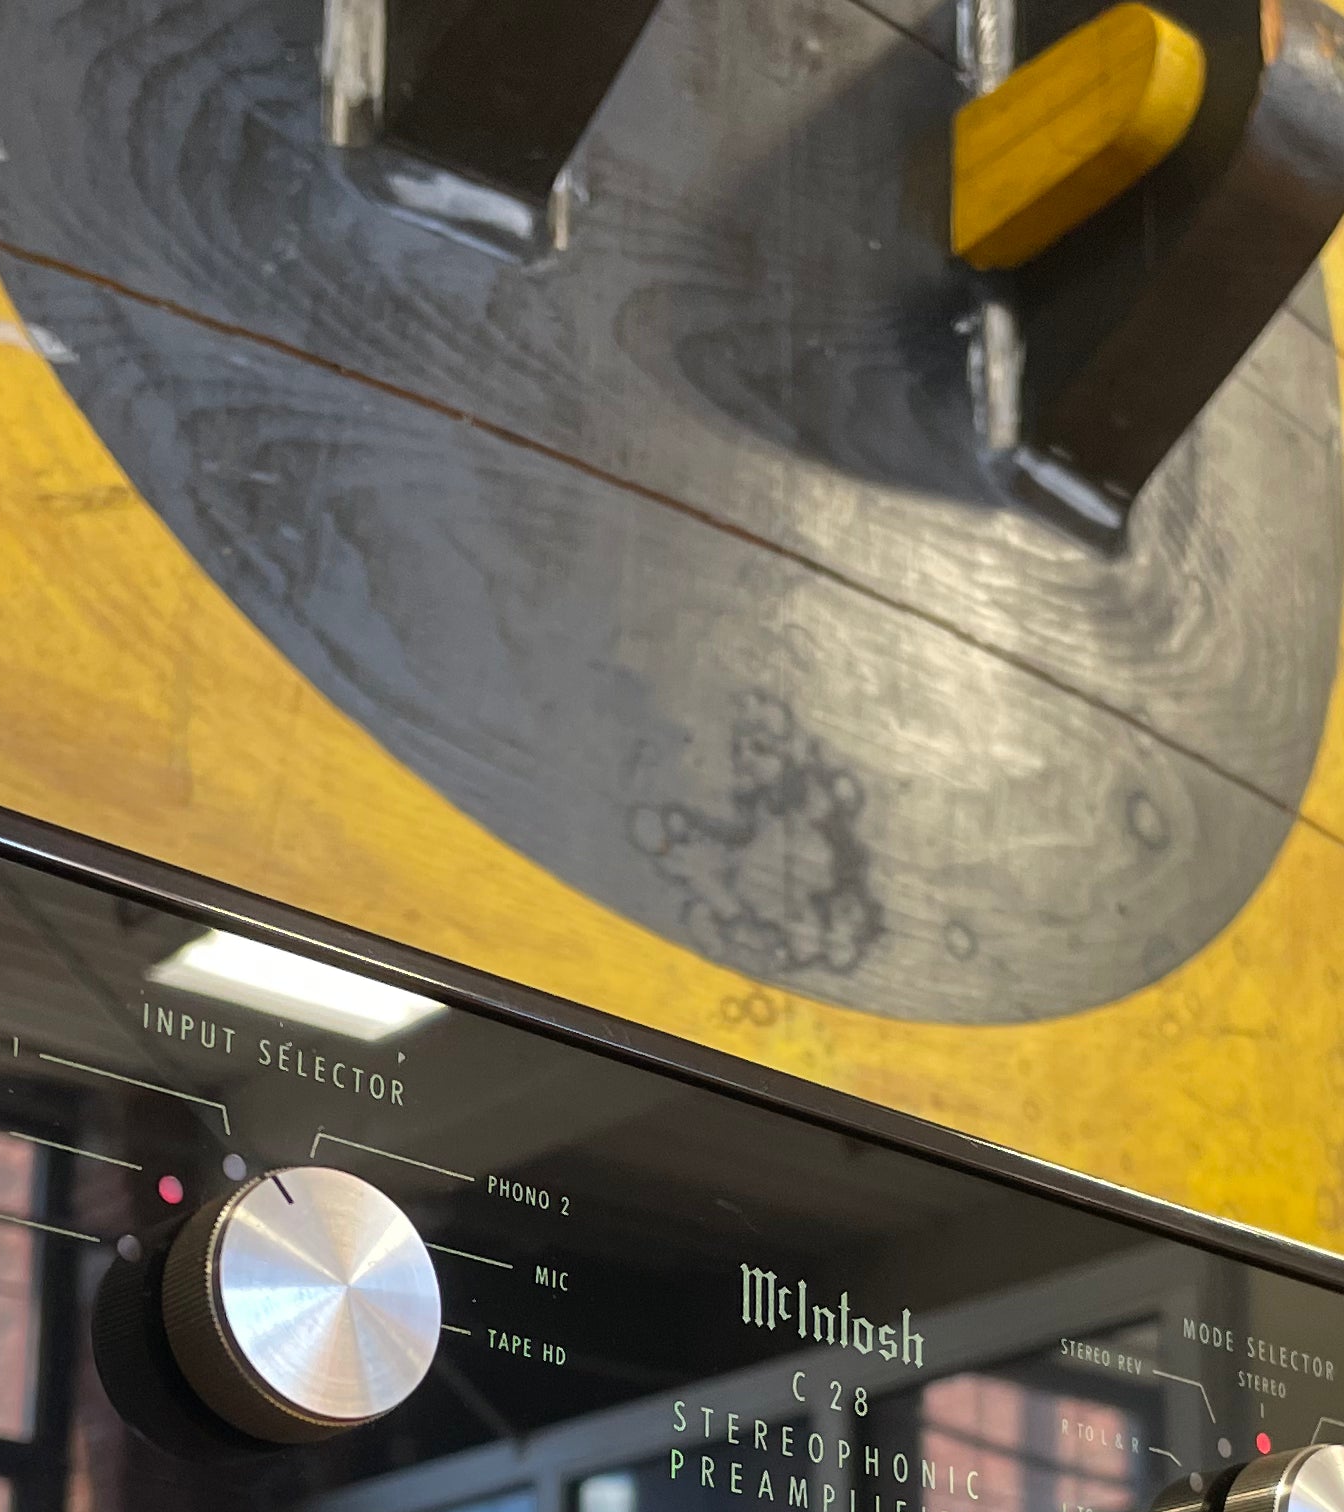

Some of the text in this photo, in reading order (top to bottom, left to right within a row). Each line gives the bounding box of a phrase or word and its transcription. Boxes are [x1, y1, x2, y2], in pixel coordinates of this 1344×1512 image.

[143, 1003, 405, 1106] INPUT SELECTOR
[487, 1175, 570, 1217] PHONO 2
[535, 1265, 569, 1291] MIC
[740, 1262, 925, 1369] McIntosh
[488, 1329, 567, 1366] TAPE HD
[1061, 1338, 1143, 1376] STEREO REV
[1183, 1317, 1336, 1382] MODE SELECTOR
[793, 1371, 806, 1402] C
[1238, 1370, 1287, 1399] STEREO
[673, 1401, 980, 1501] STEREOPHONIC
[1077, 1423, 1093, 1441] TO
